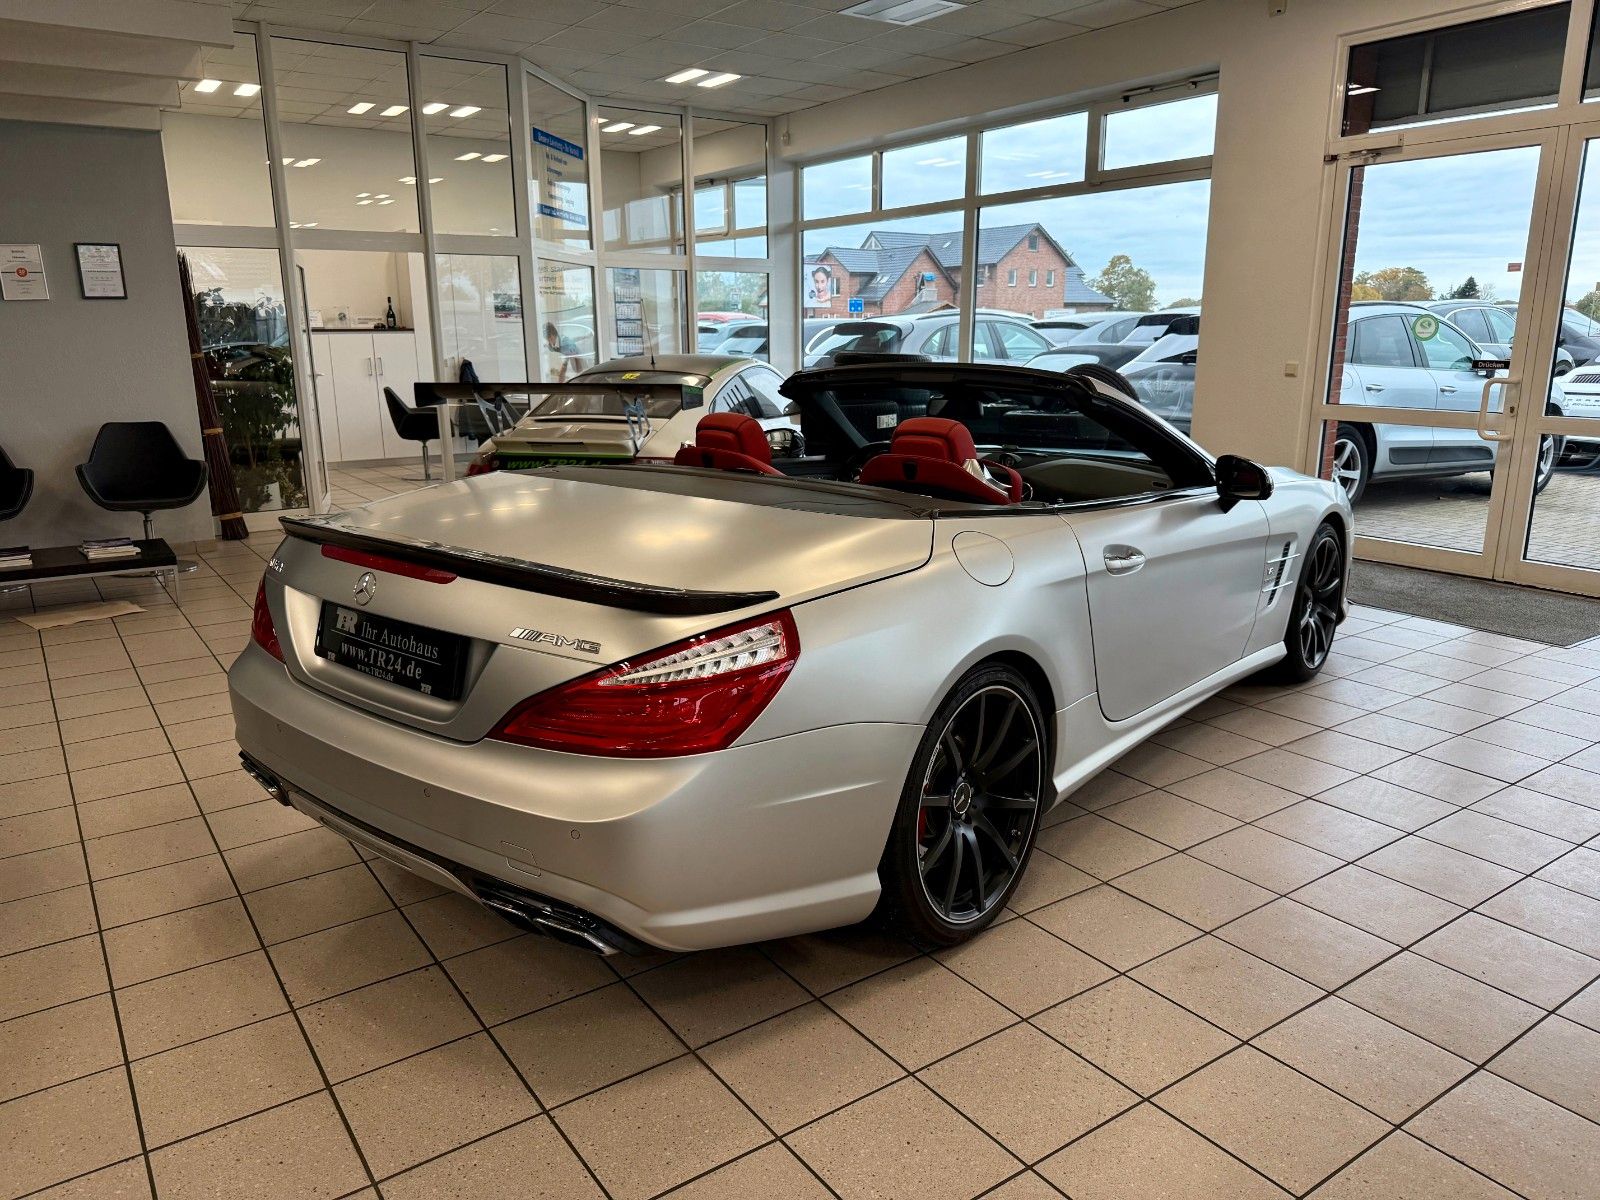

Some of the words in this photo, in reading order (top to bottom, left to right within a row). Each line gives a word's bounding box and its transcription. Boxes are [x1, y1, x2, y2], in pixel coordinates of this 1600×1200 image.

[360, 621, 377, 641] Ihr
[380, 628, 439, 659] Autohaus
[538, 631, 602, 655] AMG
[341, 642, 422, 680] www.TR24.de
[357, 664, 394, 681] www.TR24.de
